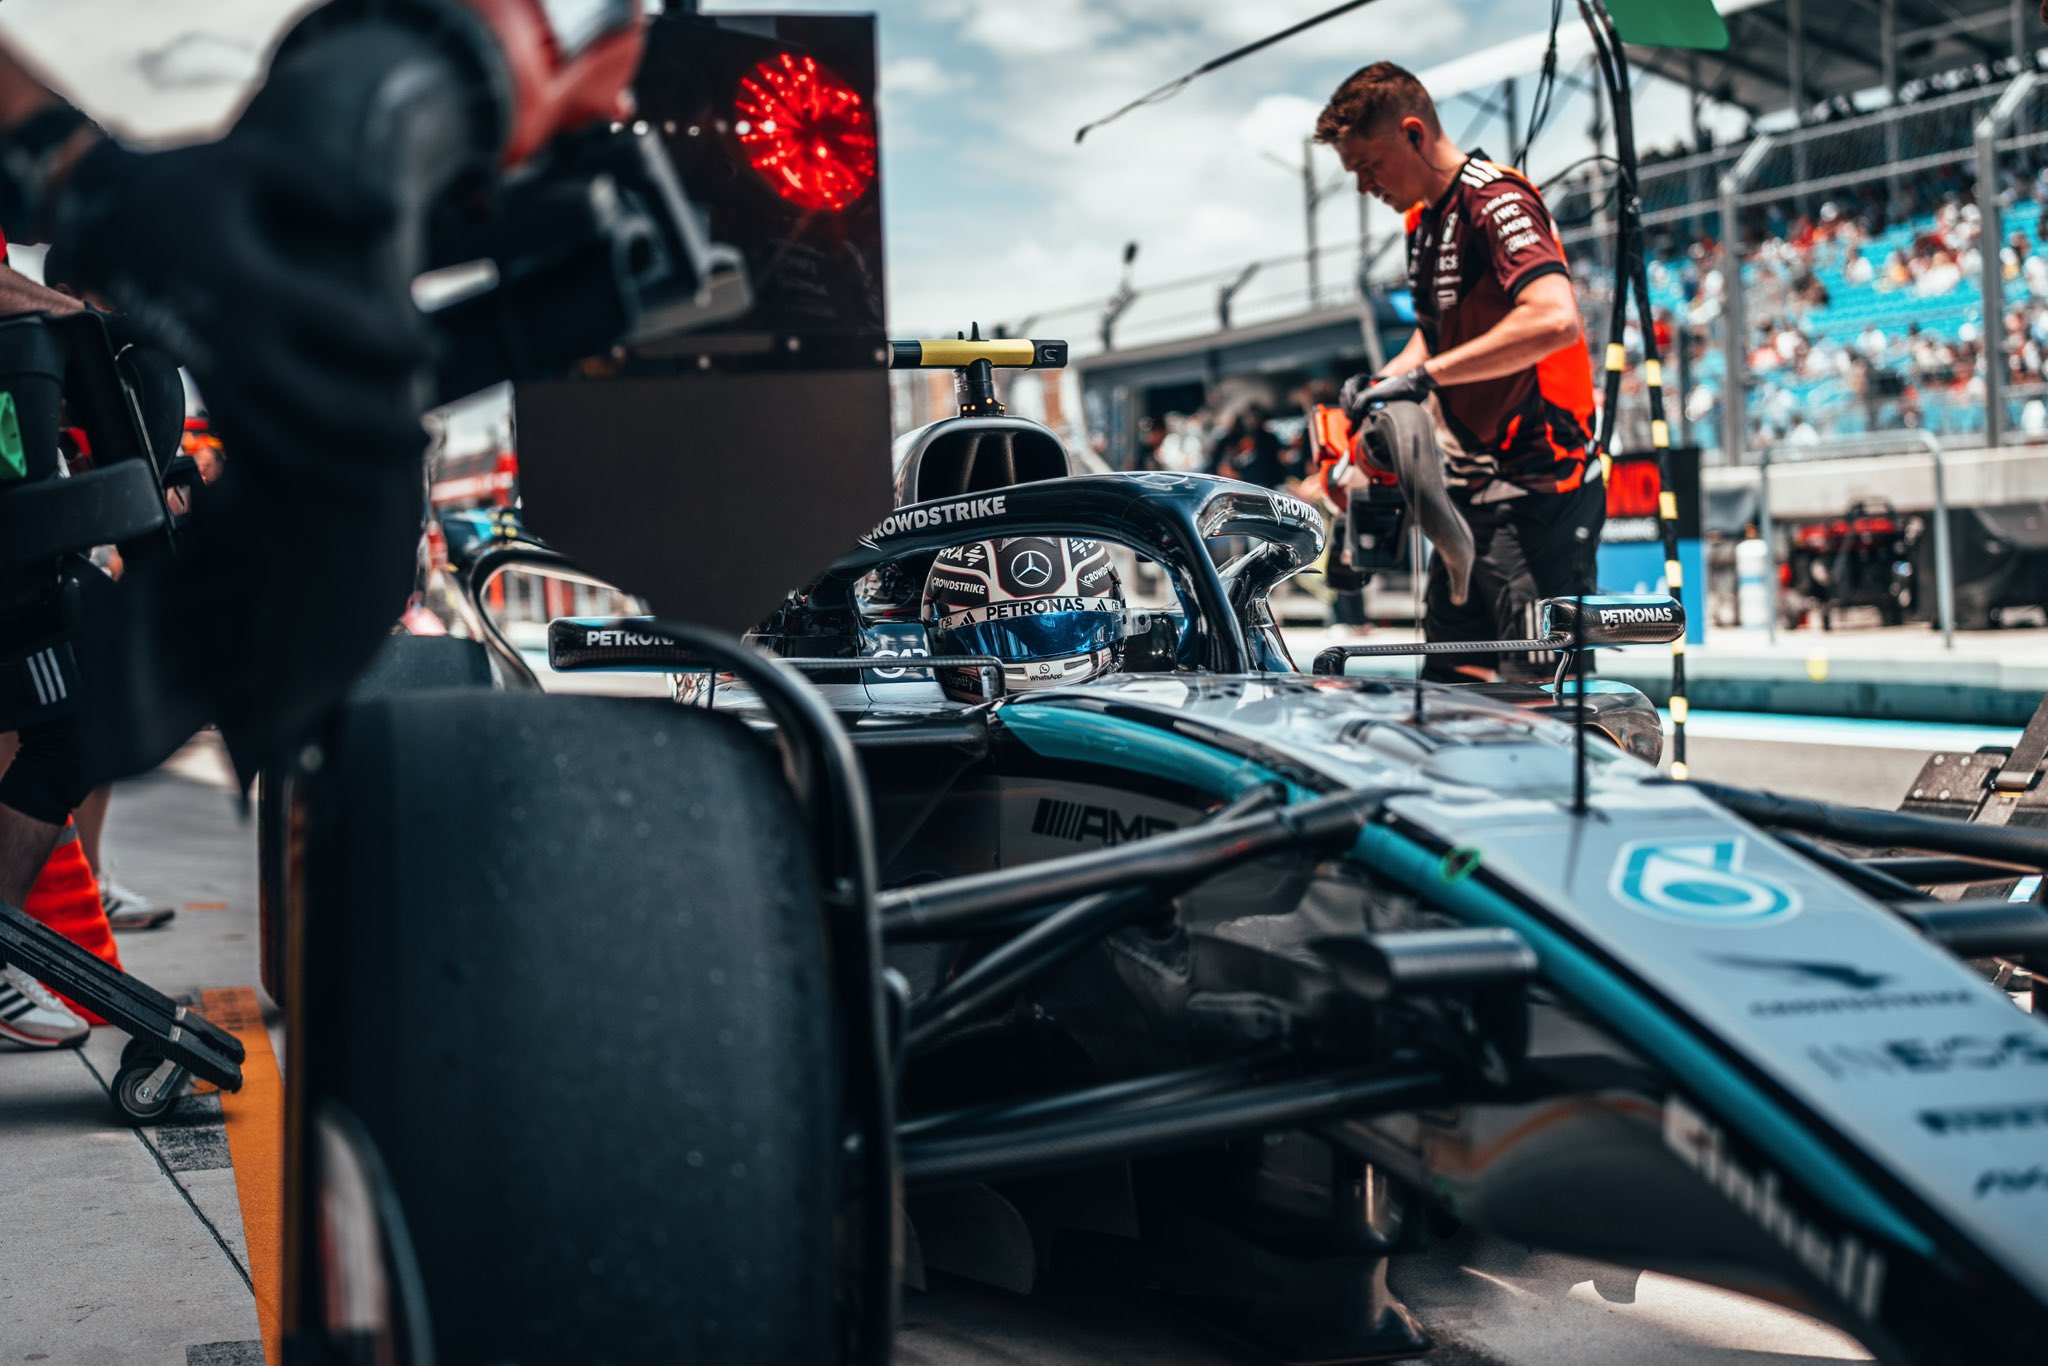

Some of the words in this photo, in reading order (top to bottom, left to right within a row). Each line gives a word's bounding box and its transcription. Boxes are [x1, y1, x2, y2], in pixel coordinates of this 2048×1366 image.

[1493, 203, 1521, 225] IWC
[863, 495, 1007, 541] ROWDSTRIKE
[985, 598, 1085, 621] PETRONAS
[1599, 607, 1673, 625] PETRONAS
[1029, 673, 1063, 681] WhatsApp
[1608, 836, 1803, 928] 6
